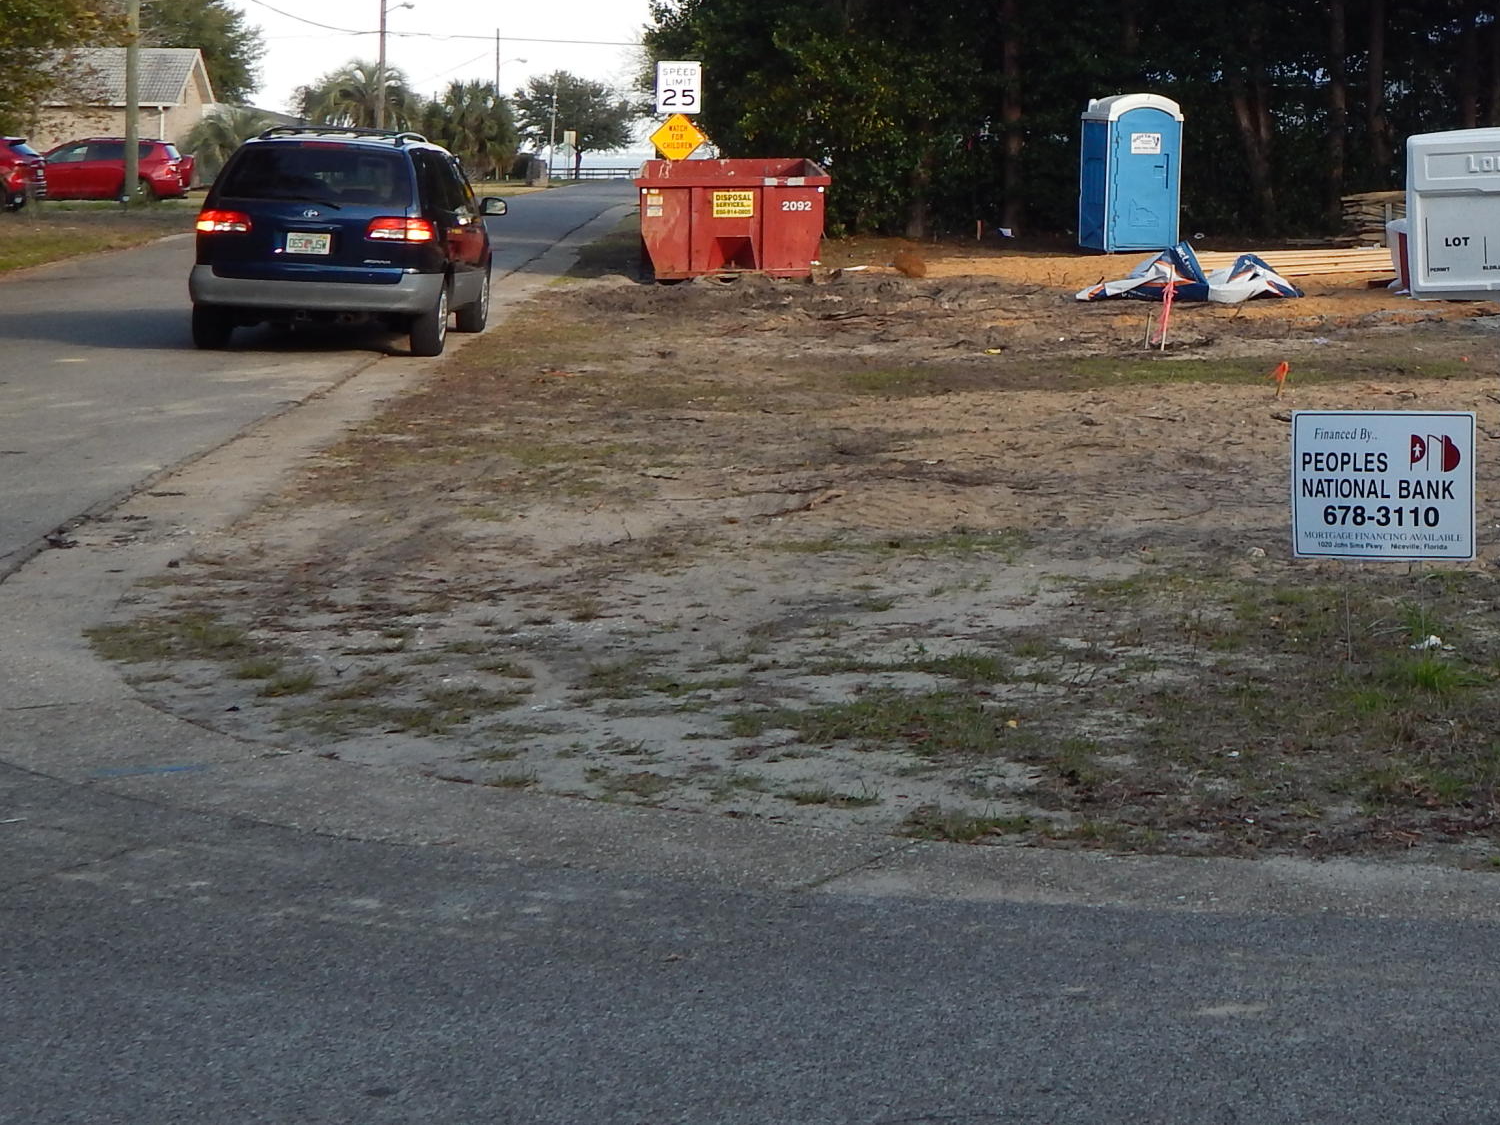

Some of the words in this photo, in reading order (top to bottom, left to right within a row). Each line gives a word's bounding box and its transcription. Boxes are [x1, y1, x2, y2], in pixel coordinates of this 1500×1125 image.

[662, 67, 697, 76] SPEED
[665, 78, 692, 86] LIMIT
[662, 89, 695, 106] 25
[671, 133, 684, 141] FOR
[782, 201, 812, 211] 2092
[1445, 236, 1470, 247] LOT
[1314, 427, 1356, 440] Financed
[1302, 452, 1388, 472] PEOPLES
[1302, 479, 1390, 499] NATIONAL
[1398, 480, 1455, 500] BANK
[1323, 505, 1440, 527] 678-3110
[1304, 531, 1354, 540] MORTGAGE
[1355, 532, 1407, 541] FINANCING
[1409, 533, 1463, 542] AVAILABLE
